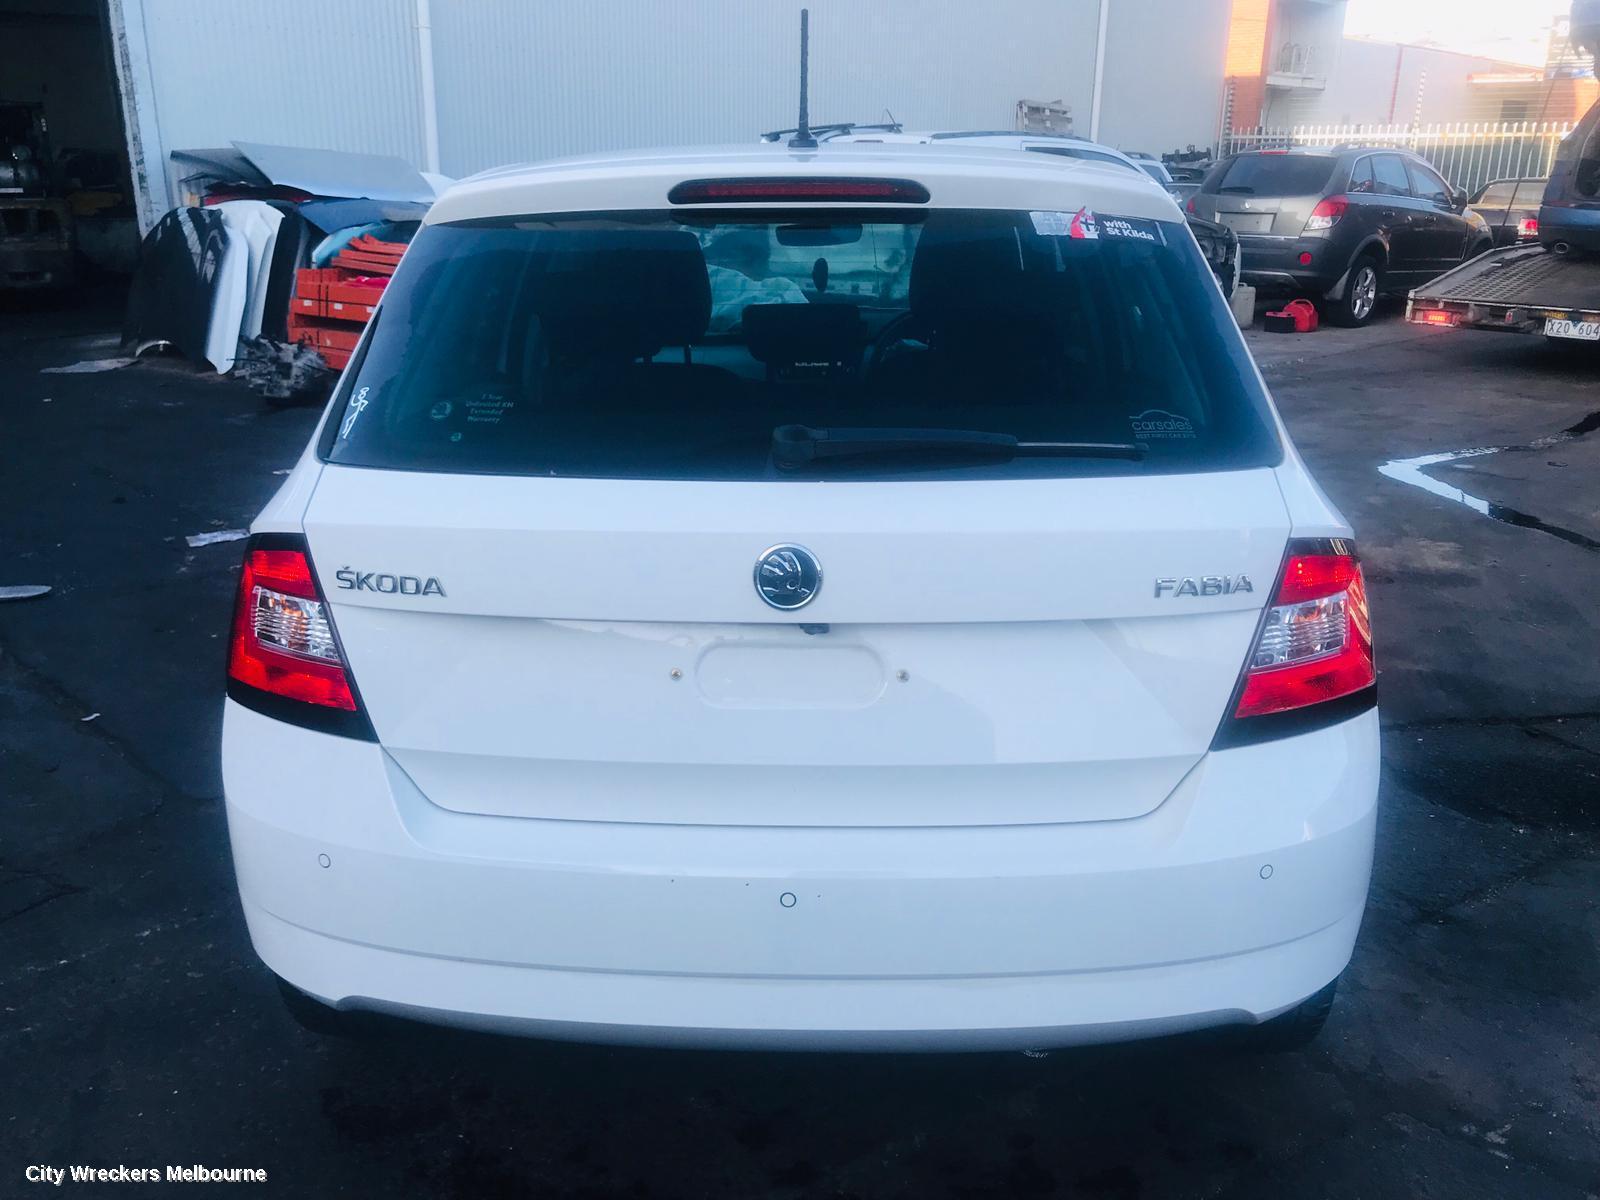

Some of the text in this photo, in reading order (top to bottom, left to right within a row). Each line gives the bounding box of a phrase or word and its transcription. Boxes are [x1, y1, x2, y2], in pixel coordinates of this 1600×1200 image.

[1103, 220, 1131, 230] with
[1106, 227, 1155, 240] St Kilda
[1549, 319, 1599, 337] X20 604
[1131, 419, 1193, 431] carsales
[336, 566, 447, 597] ŠKODA
[1154, 574, 1254, 598] FABIA
